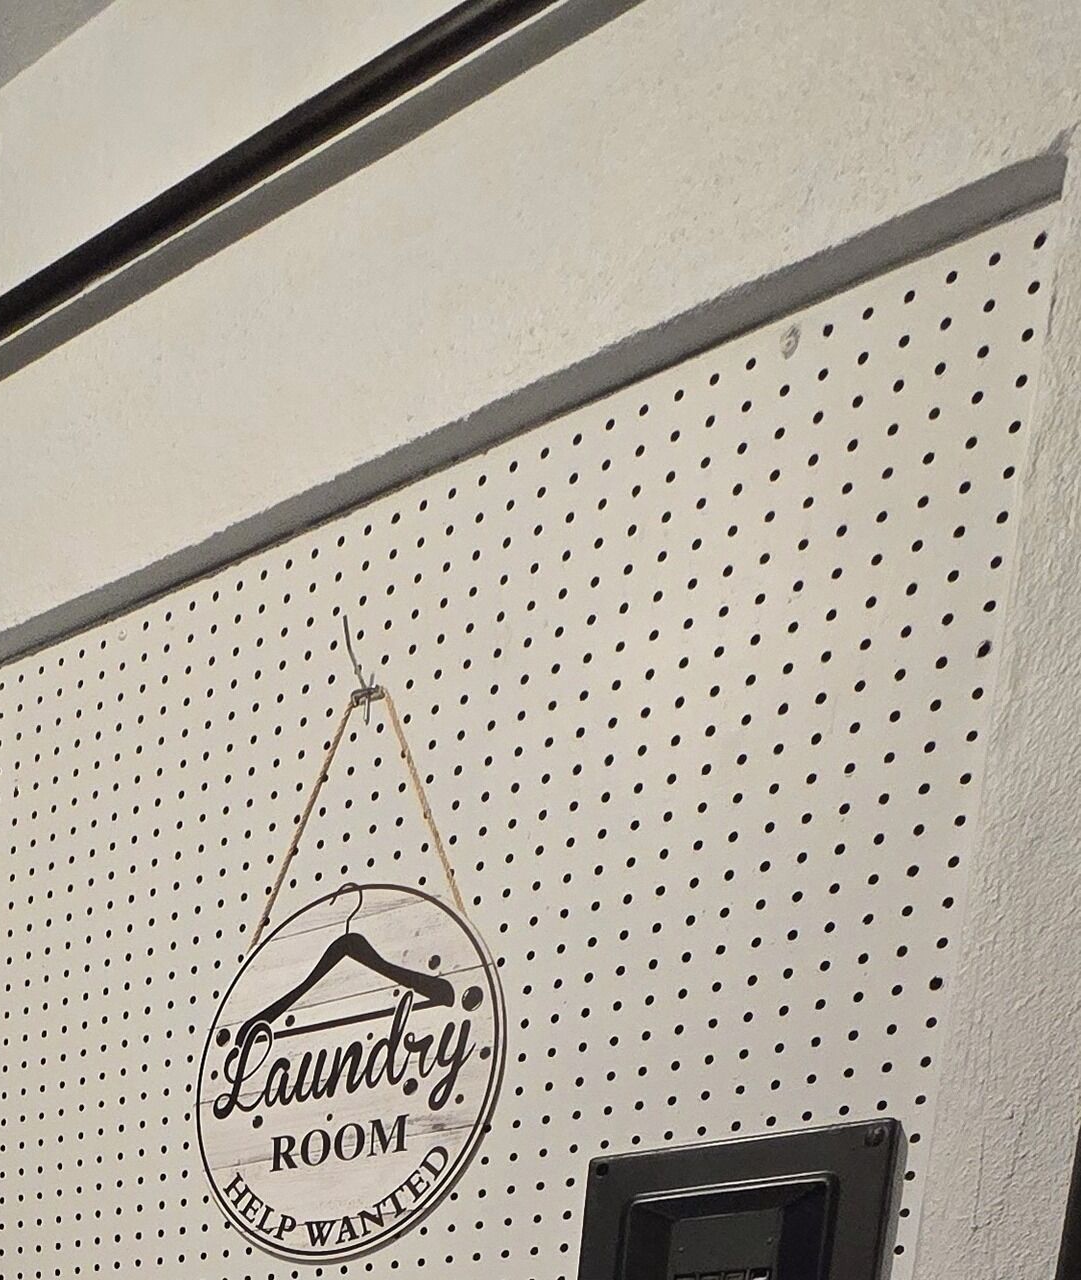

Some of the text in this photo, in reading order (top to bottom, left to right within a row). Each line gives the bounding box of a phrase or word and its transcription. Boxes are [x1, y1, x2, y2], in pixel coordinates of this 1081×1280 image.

[213, 990, 477, 1119] Laundry
[270, 1114, 410, 1173] ROOM
[222, 1145, 450, 1247] HELP WANTED
